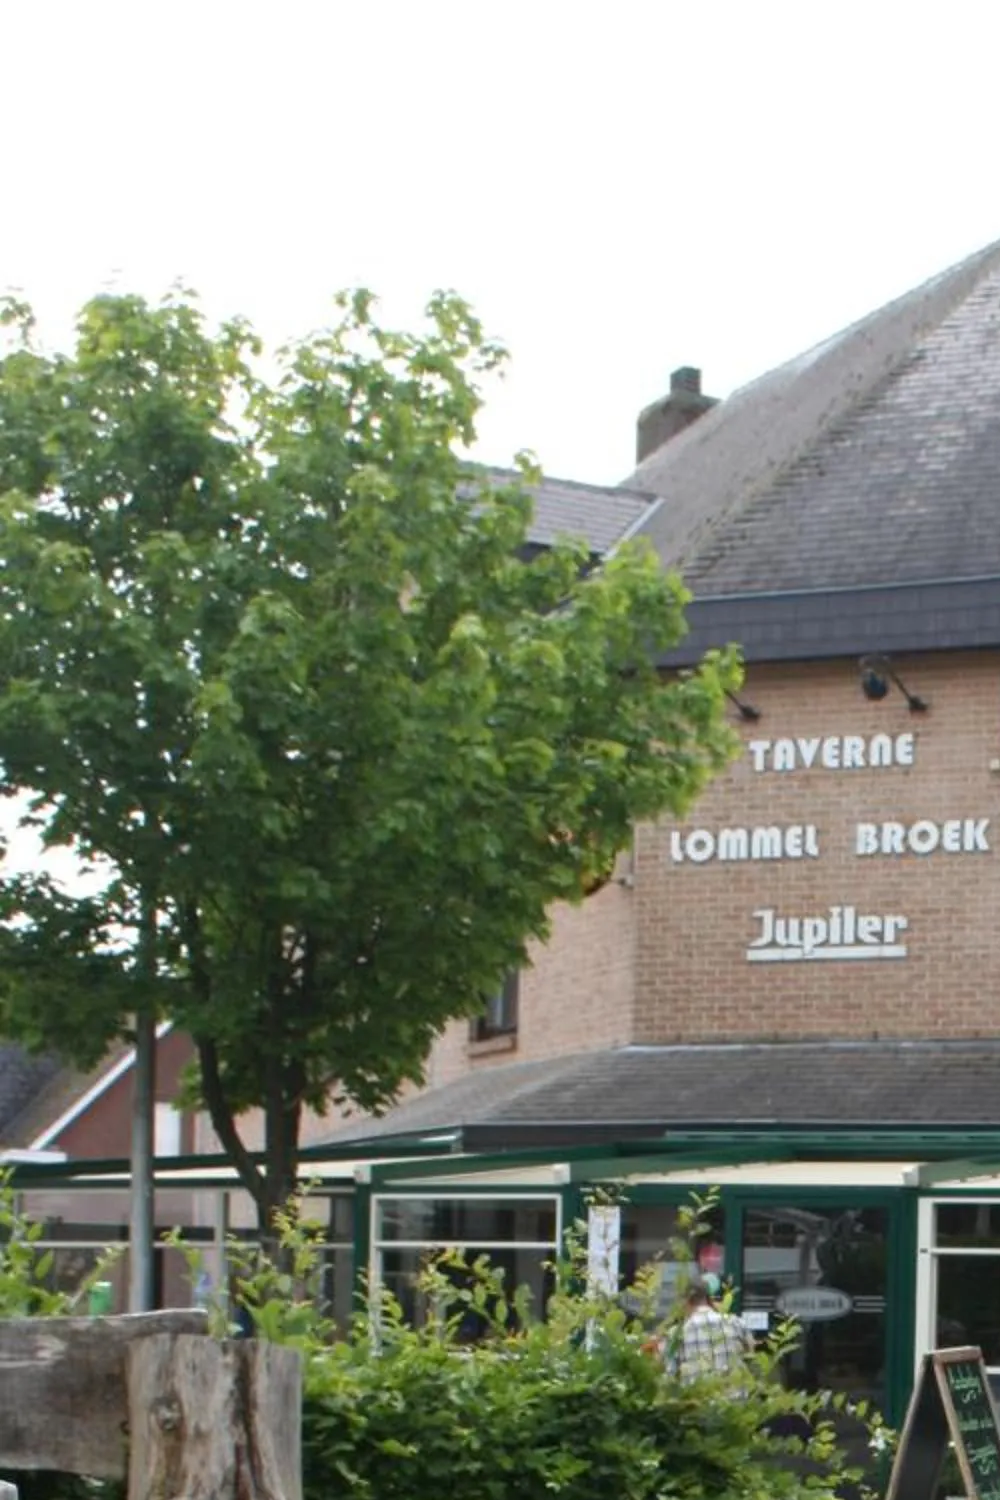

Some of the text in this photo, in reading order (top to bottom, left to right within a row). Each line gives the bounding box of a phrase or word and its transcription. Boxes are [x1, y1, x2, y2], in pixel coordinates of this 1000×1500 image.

[749, 733, 914, 772] TAVERNE
[670, 818, 990, 862] LOMMEL BROEK
[750, 906, 908, 956] Jupiler
